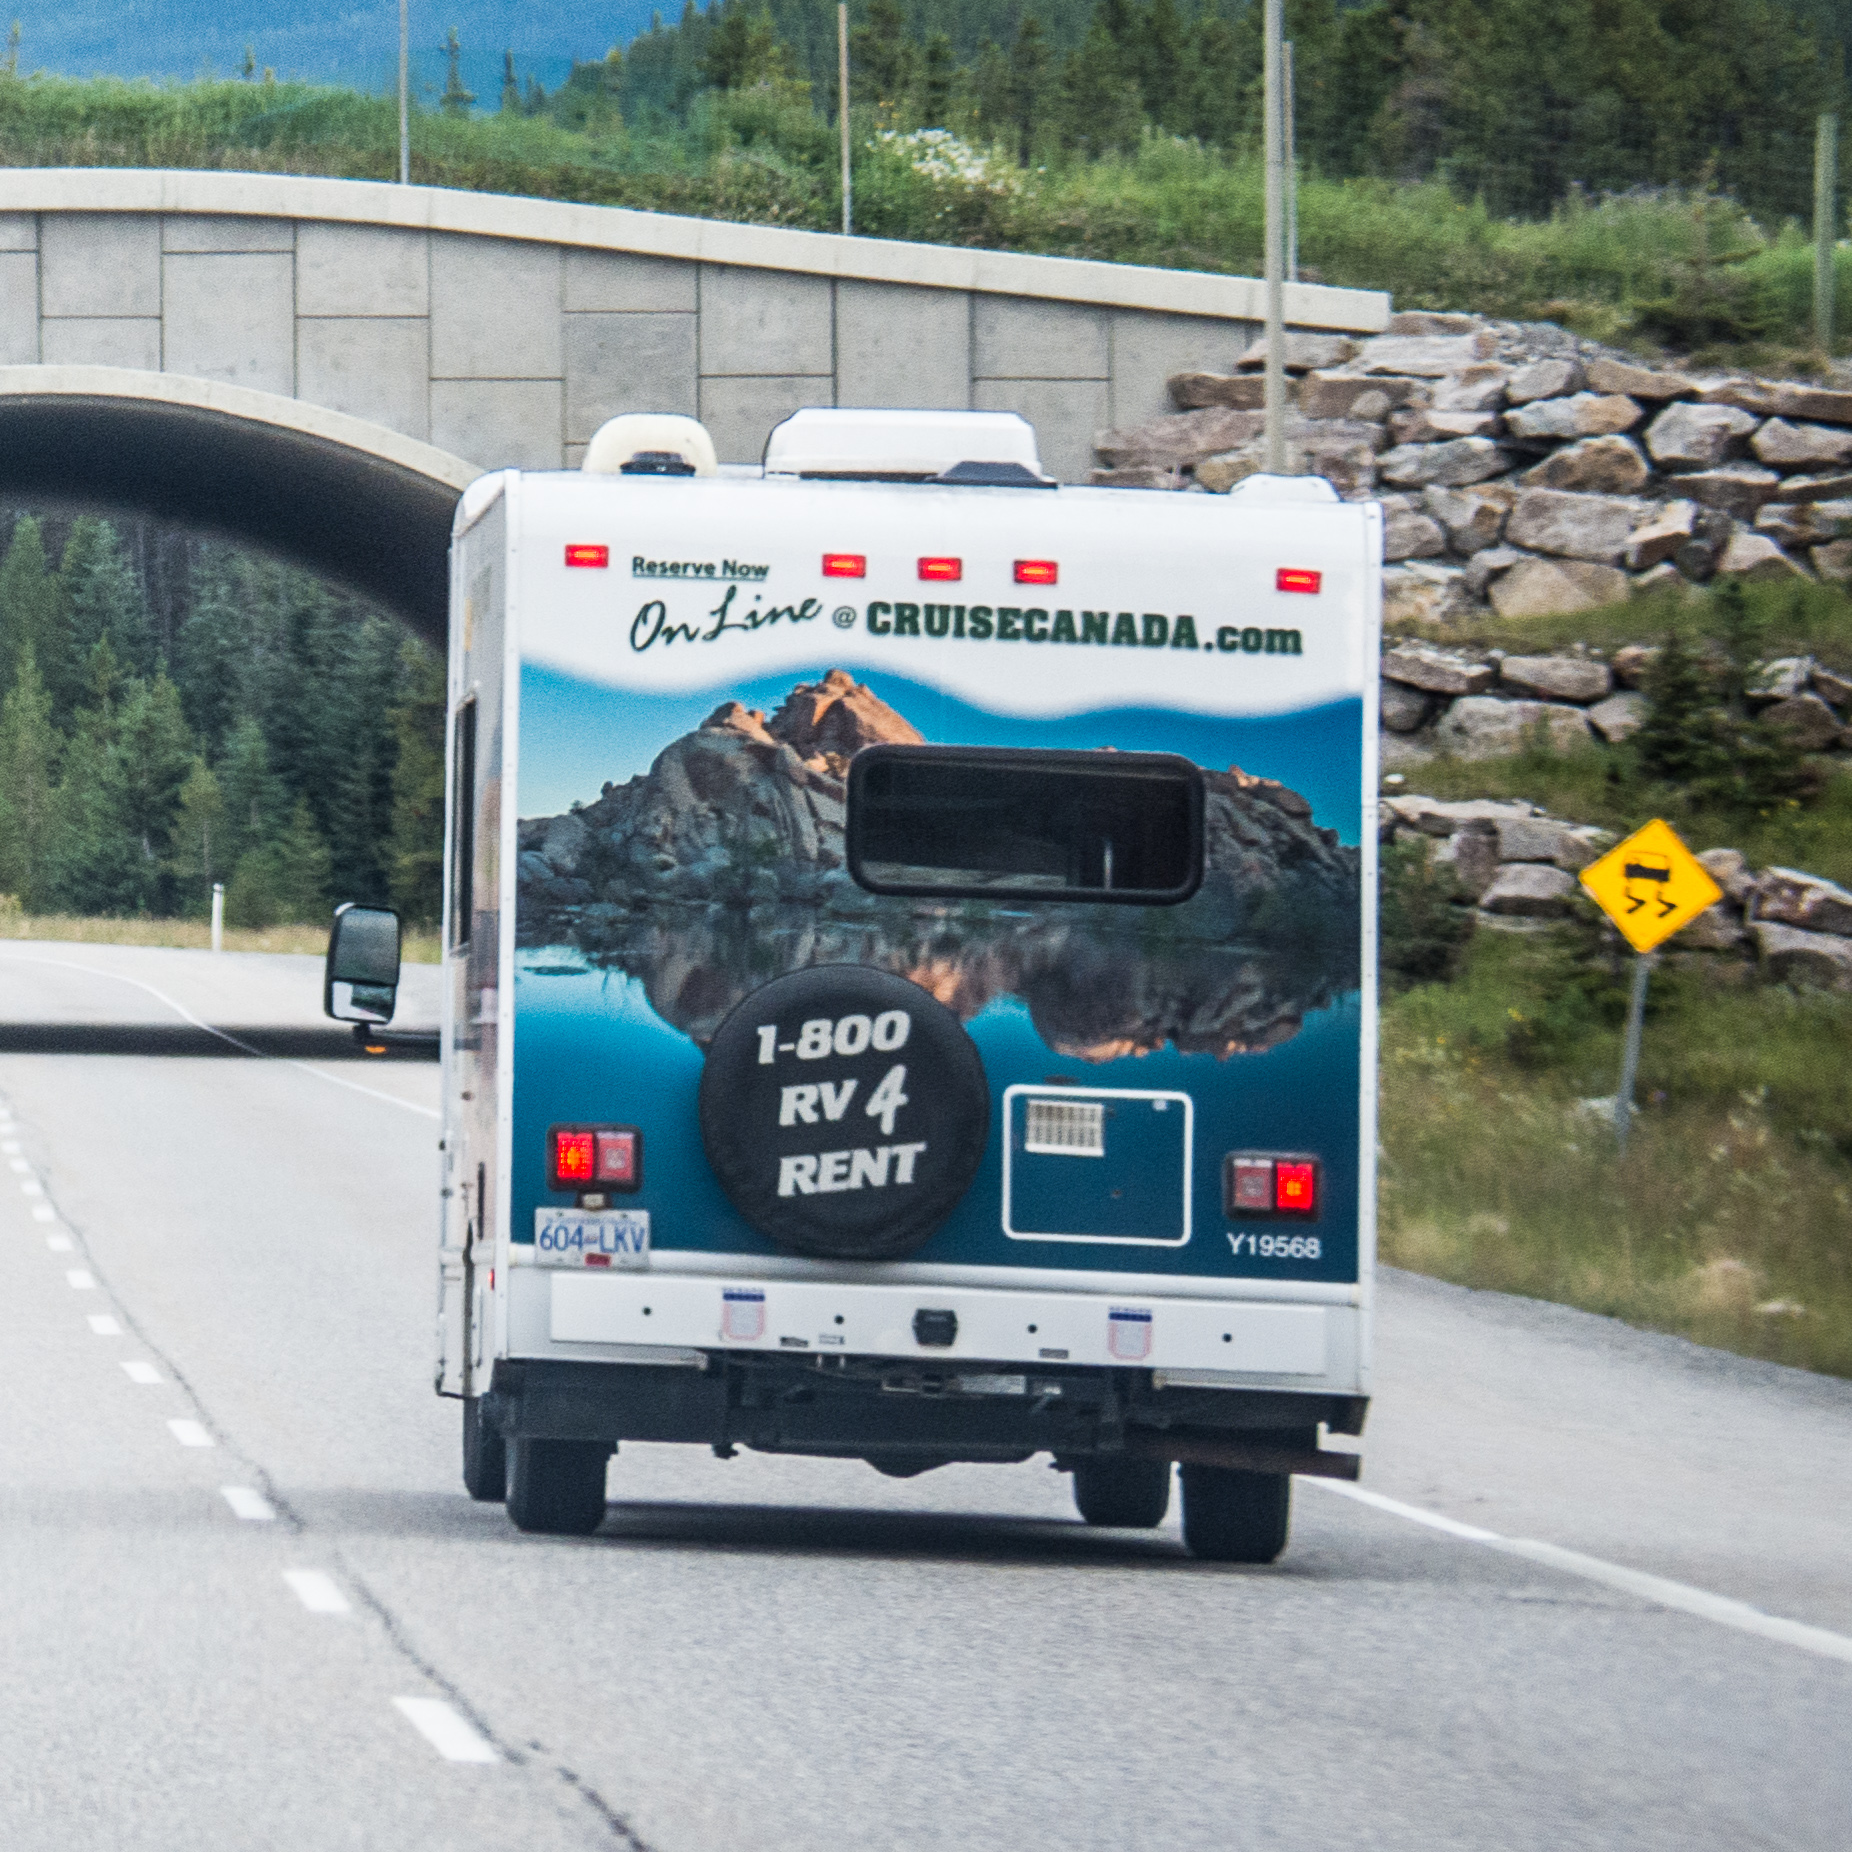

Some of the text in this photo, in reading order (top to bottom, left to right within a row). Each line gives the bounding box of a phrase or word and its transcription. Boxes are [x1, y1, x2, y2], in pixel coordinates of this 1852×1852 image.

[631, 555, 770, 577] Reserve Now
[630, 584, 1304, 656] On Line @ CRUISECANADA.com
[756, 1009, 911, 1065] 1-800
[778, 1063, 910, 1136] RV 4
[777, 1140, 928, 1198] RENT
[1226, 1231, 1323, 1260] Y19568
